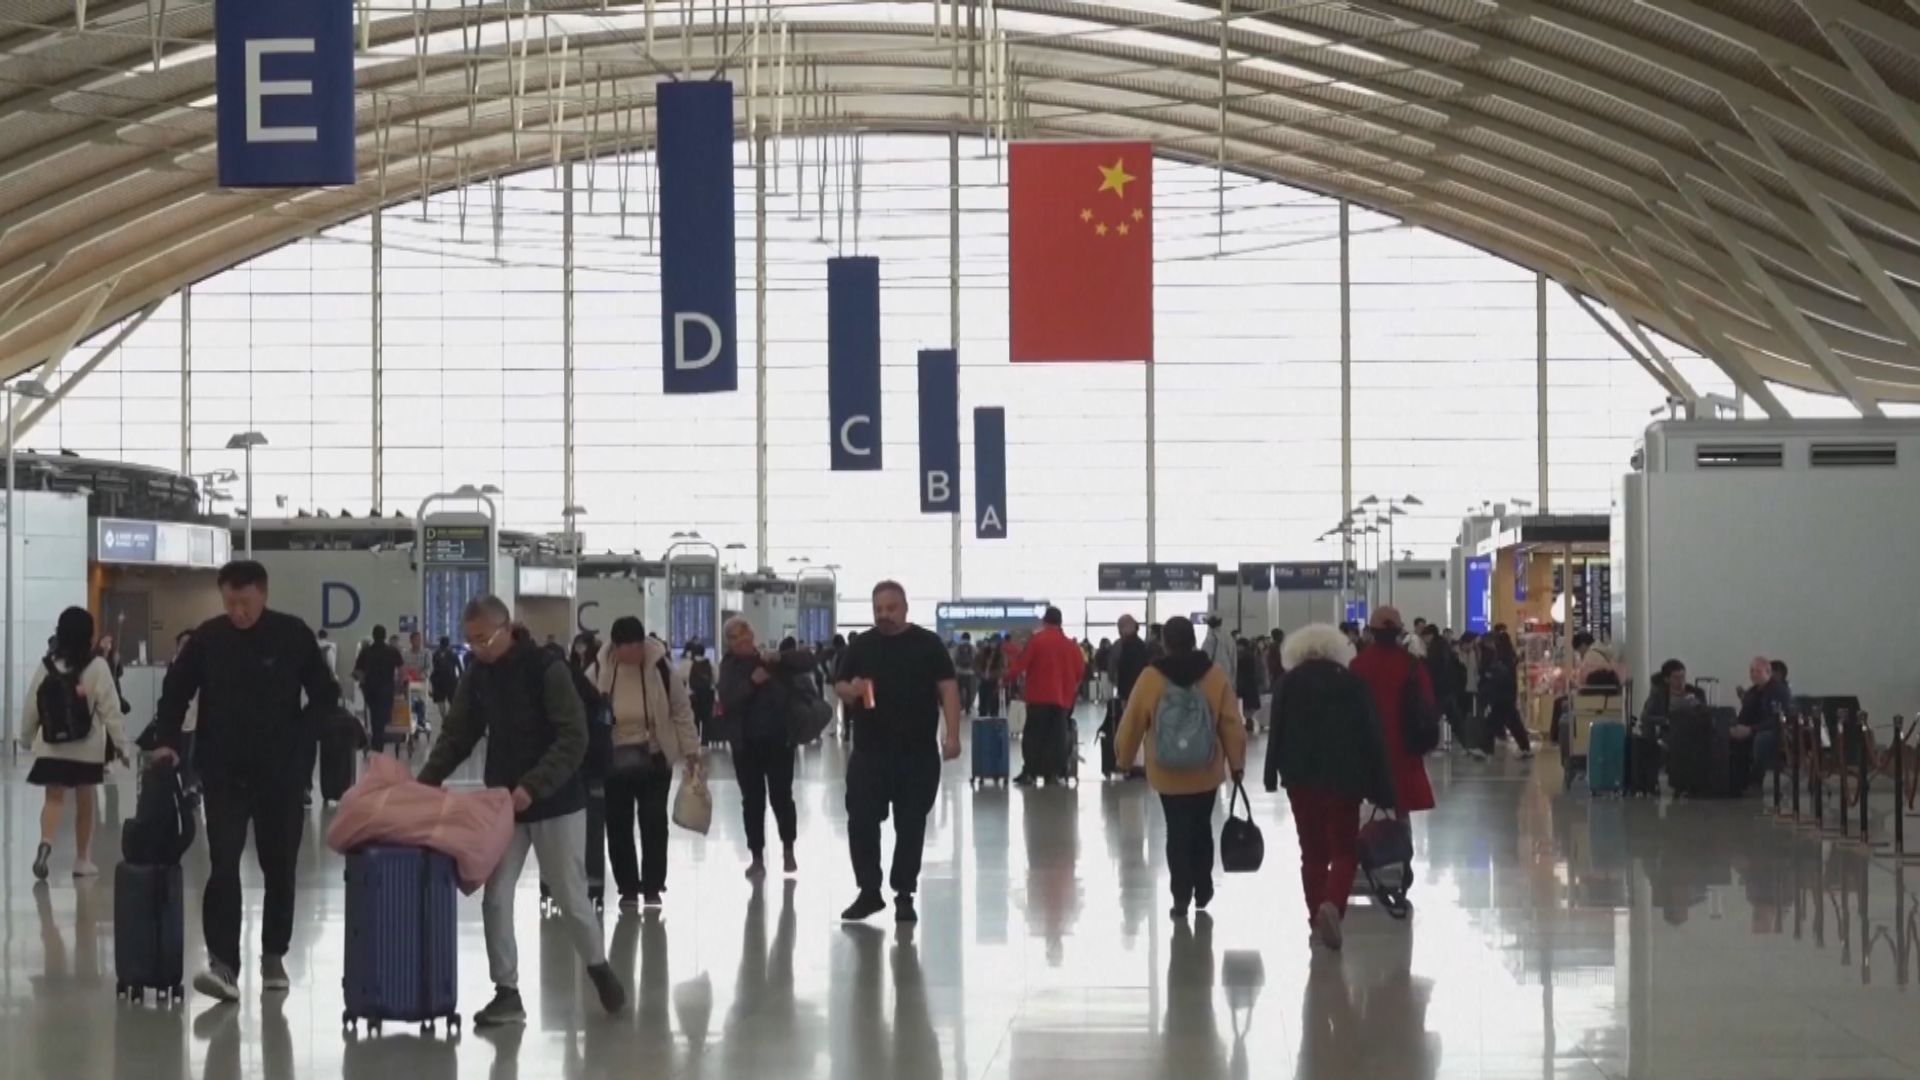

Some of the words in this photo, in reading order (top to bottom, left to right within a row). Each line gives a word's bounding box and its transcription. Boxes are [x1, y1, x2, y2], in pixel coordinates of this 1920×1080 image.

[246, 39, 318, 142] E
[674, 313, 721, 368] D
[840, 415, 871, 455] C
[927, 470, 950, 502] B
[426, 528, 436, 539] D
[980, 505, 1002, 530] A
[322, 582, 360, 628] D
[578, 602, 600, 634] C
